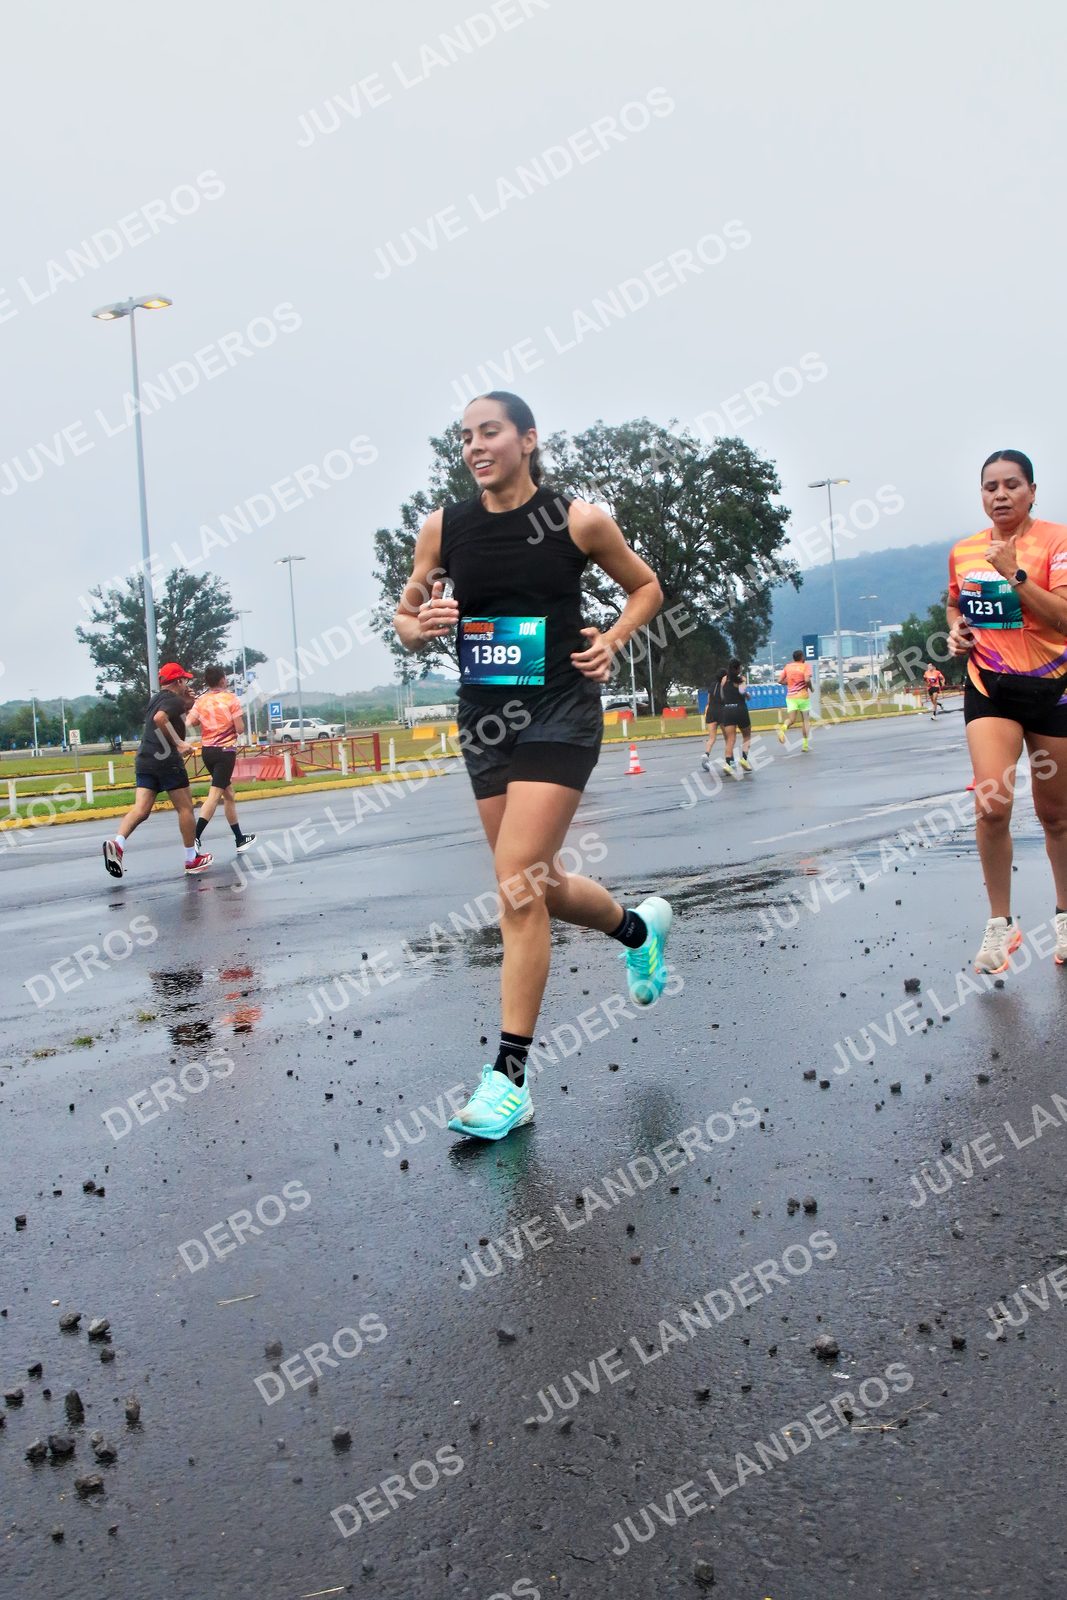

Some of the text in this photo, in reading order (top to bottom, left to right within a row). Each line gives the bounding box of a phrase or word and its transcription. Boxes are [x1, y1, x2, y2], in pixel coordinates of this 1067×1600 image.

[999, 583, 1012, 594] 10K
[967, 601, 1003, 615] 1231
[519, 622, 538, 636] 10K
[471, 645, 522, 665] 1389
[806, 646, 814, 657] E
